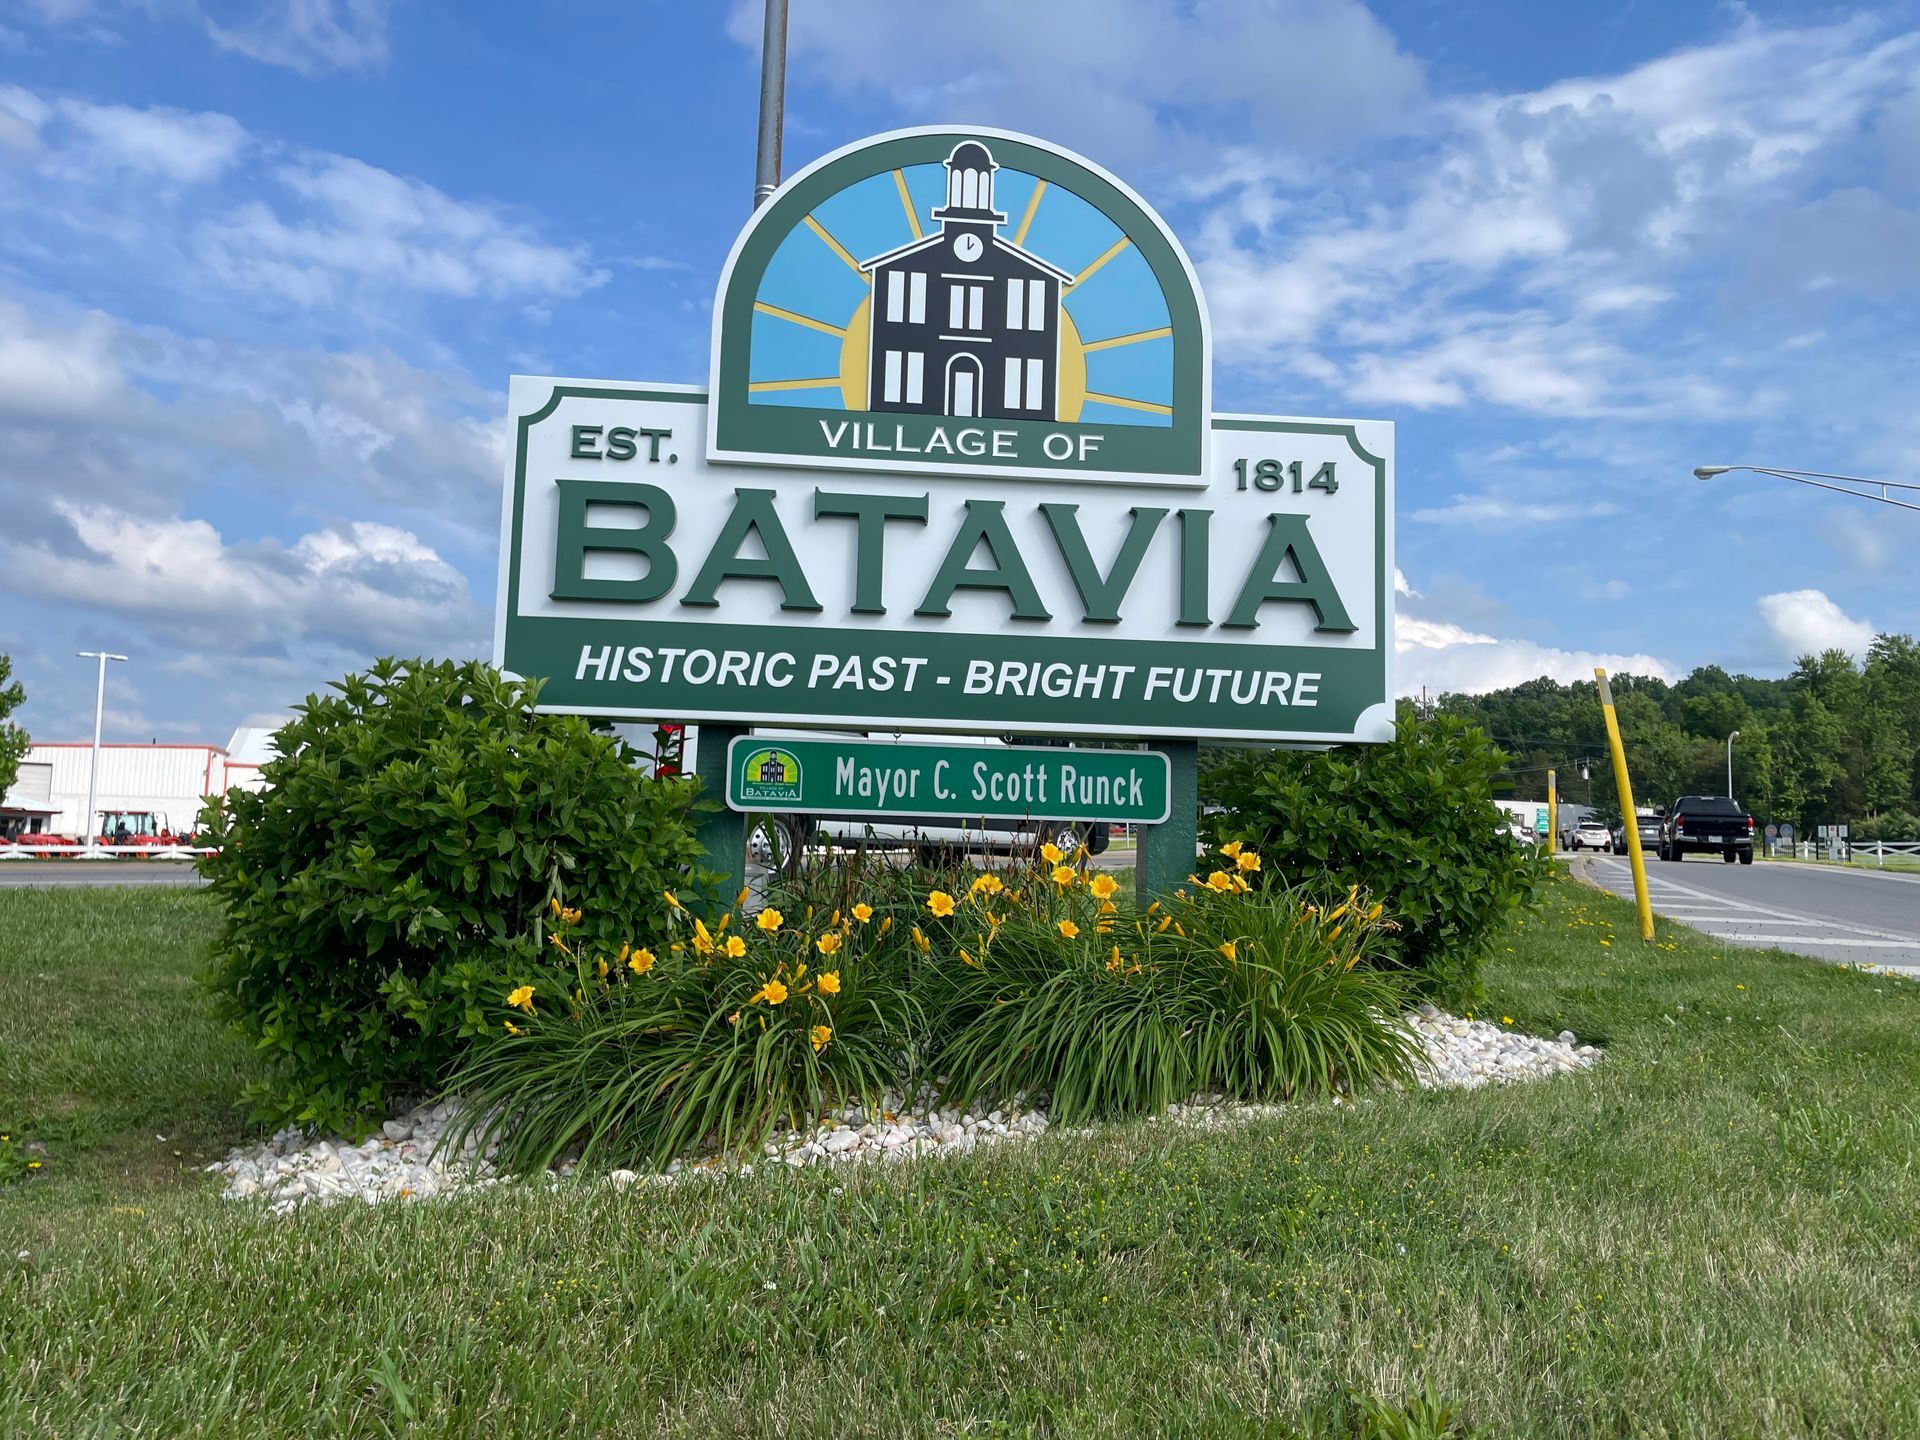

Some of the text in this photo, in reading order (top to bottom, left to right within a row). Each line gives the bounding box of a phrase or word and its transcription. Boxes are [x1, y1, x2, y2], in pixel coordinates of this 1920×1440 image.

[570, 424, 678, 463] EST.
[819, 419, 1105, 461] VILLAGE OF
[1234, 457, 1340, 494] 1814
[548, 479, 1359, 634] BATAVIA
[574, 645, 1322, 707] HISTORIC PAST - BRIGHT FUTURE
[746, 787, 796, 797] BATAVIA
[835, 756, 1144, 807] Mayor C. Scott Runck
